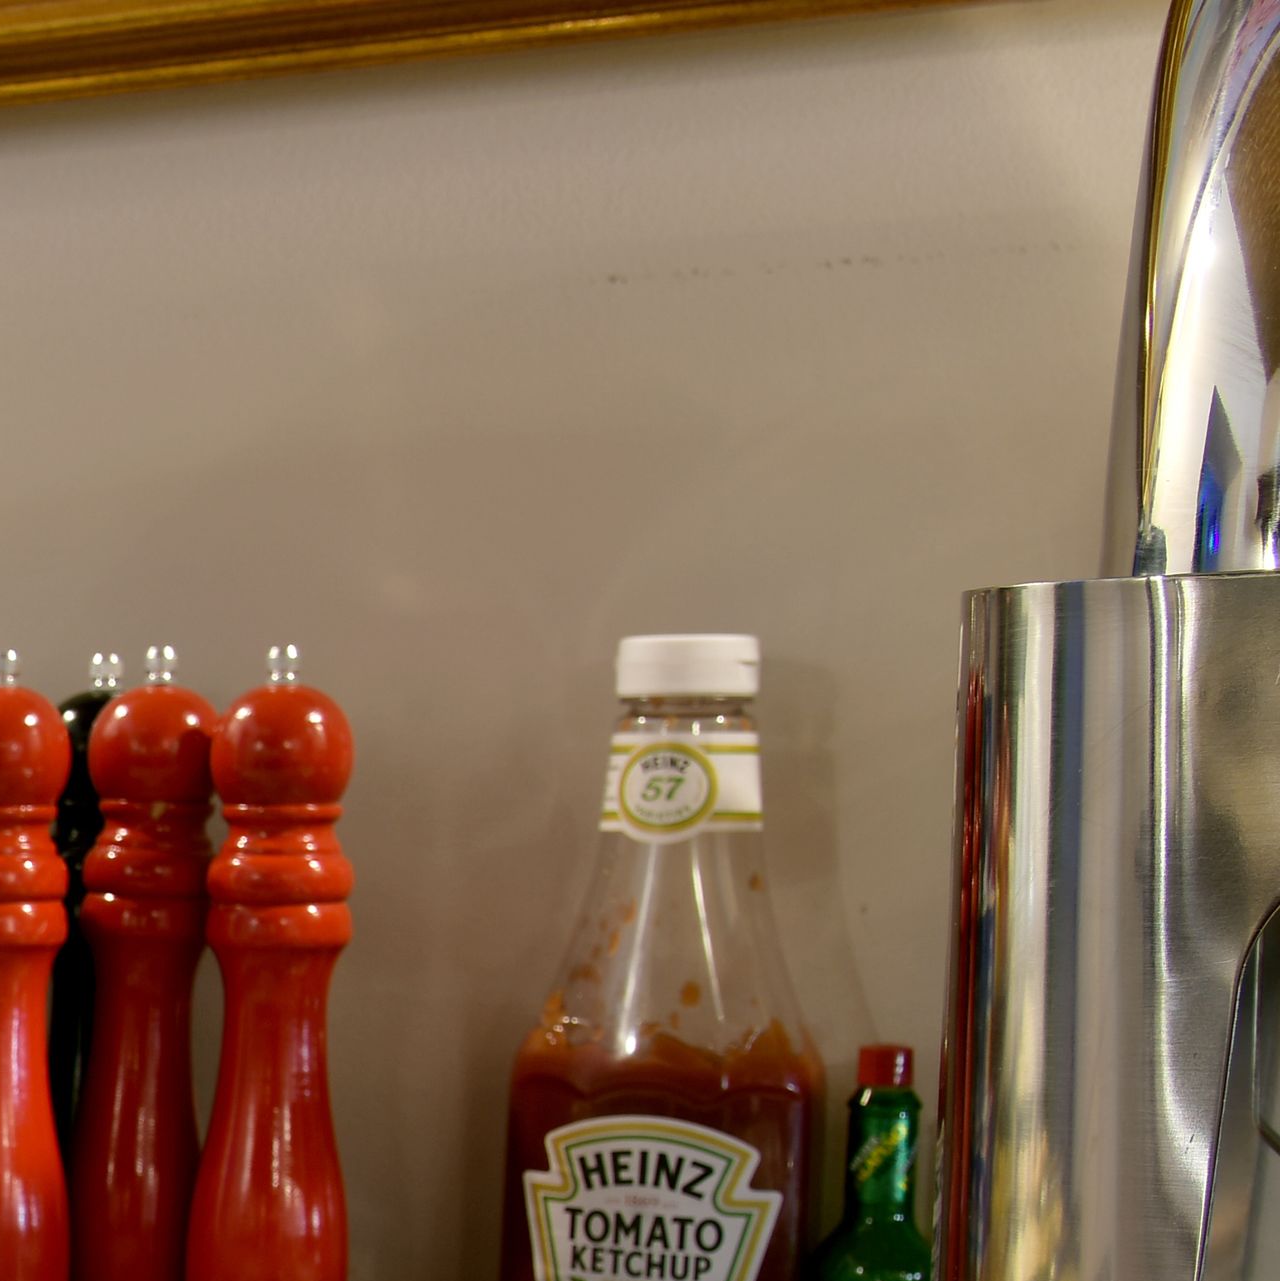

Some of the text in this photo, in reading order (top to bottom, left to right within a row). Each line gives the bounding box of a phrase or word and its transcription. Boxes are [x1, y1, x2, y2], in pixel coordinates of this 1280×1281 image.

[641, 757, 690, 774] HEINZ
[642, 777, 685, 801] 57
[579, 1150, 715, 1200] HEINZ
[564, 1207, 724, 1253] TOMATO
[571, 1245, 712, 1281] KETCHUP
